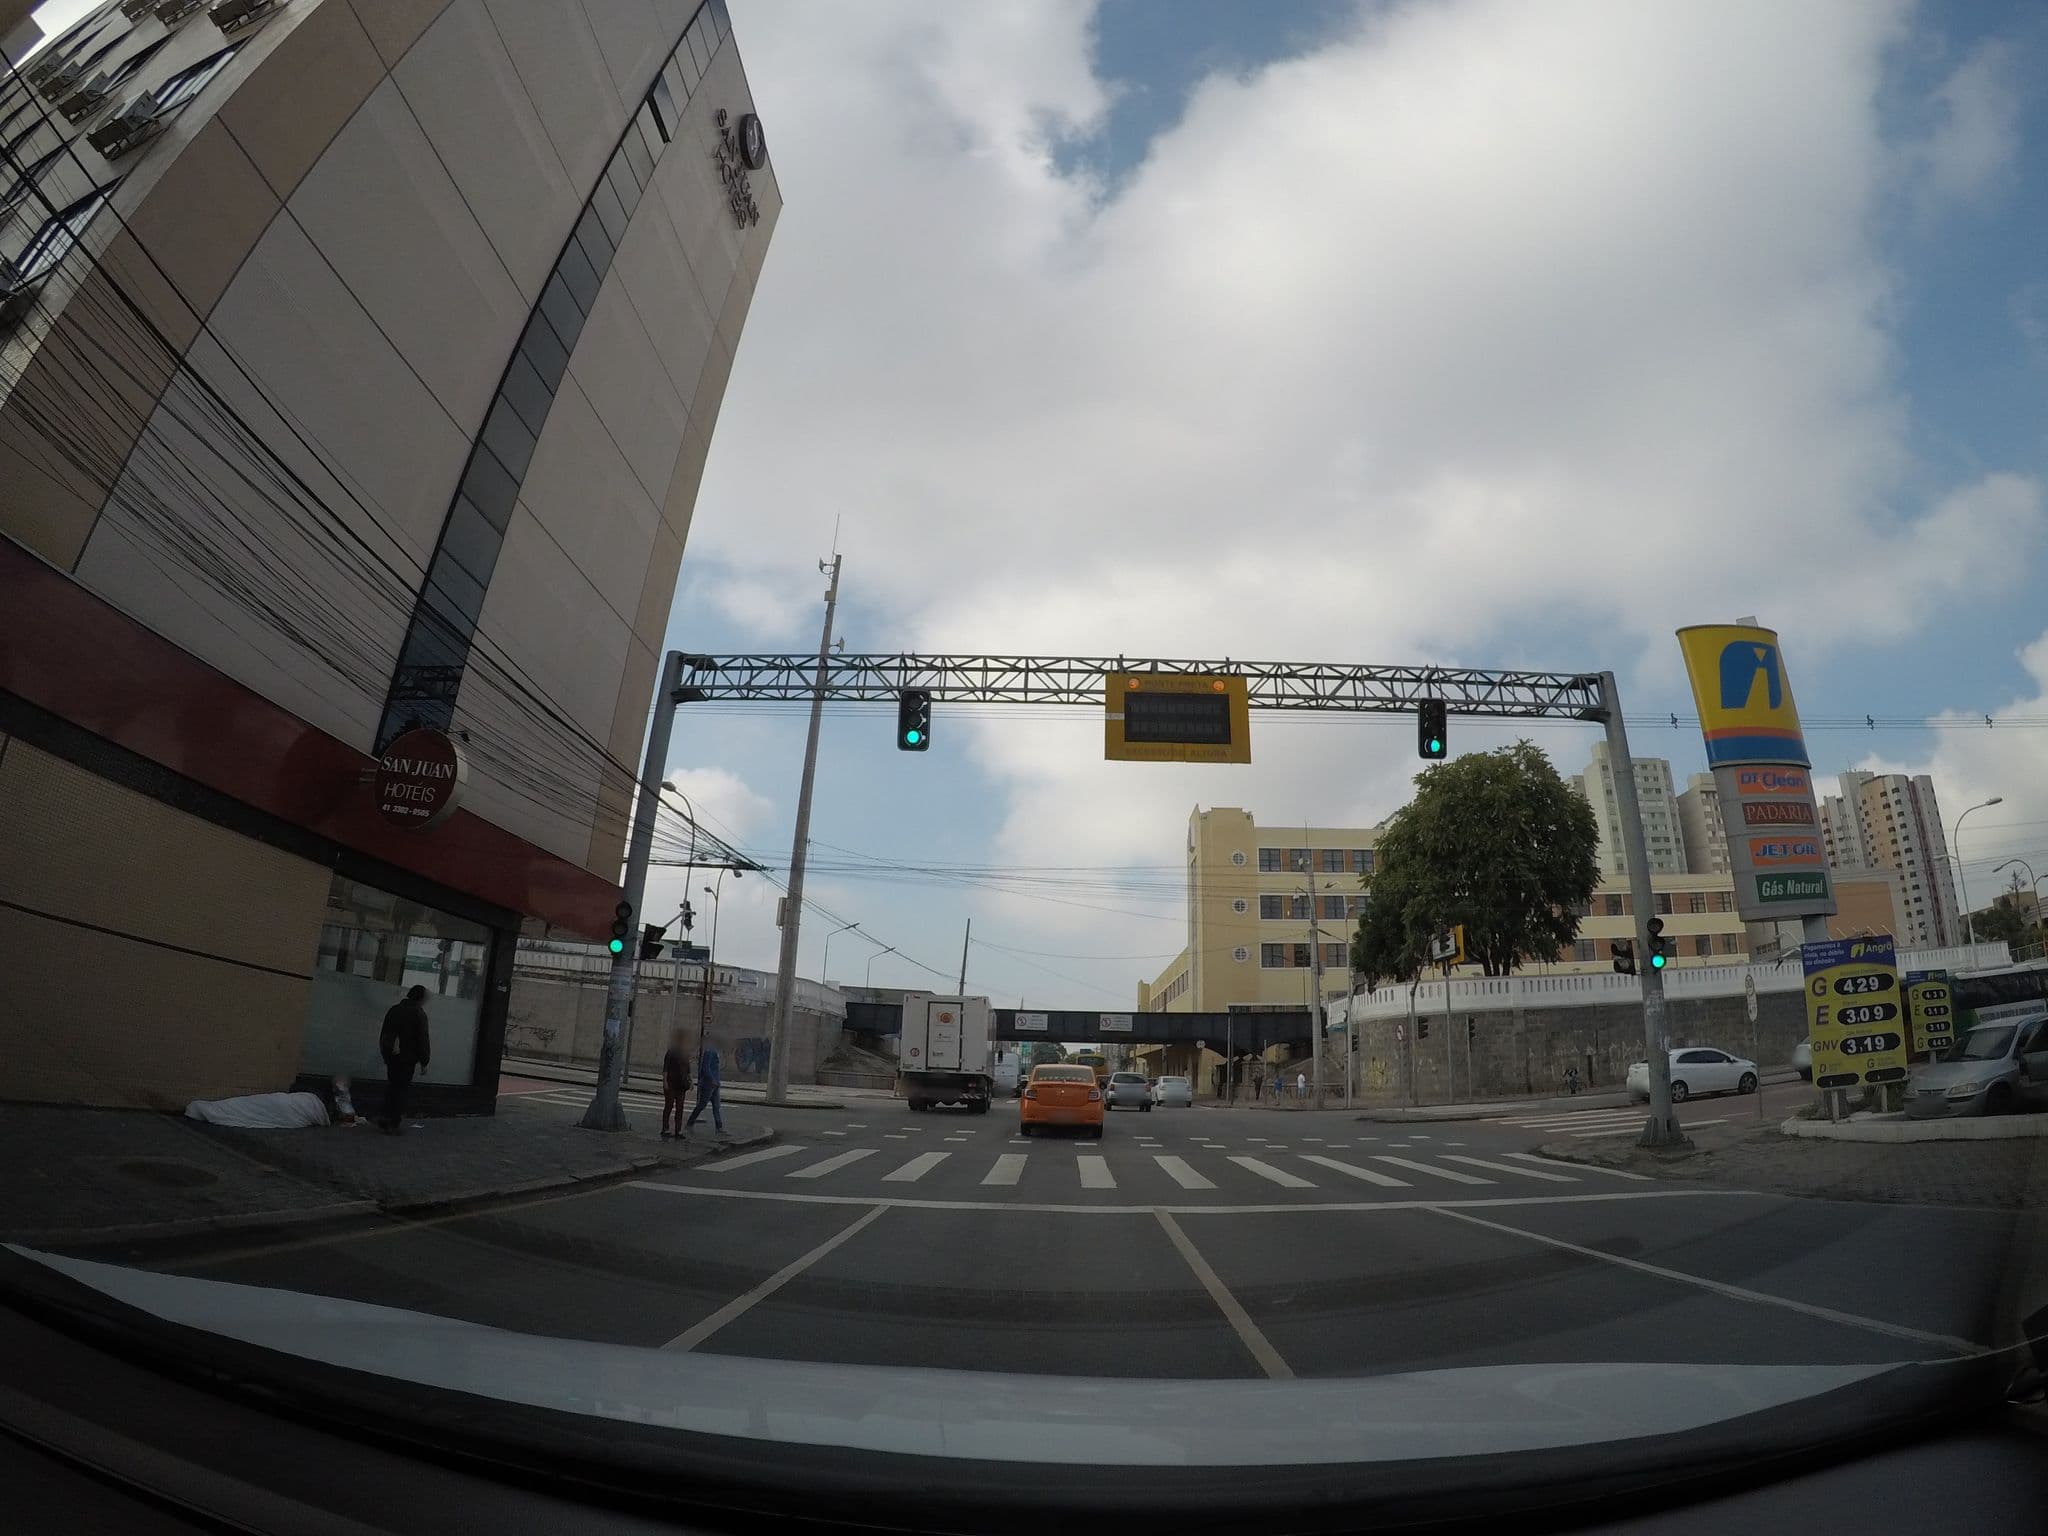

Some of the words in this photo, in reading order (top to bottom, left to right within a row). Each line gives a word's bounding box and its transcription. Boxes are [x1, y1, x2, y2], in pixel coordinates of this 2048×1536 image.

[381, 756, 412, 775] SAN
[411, 760, 455, 780] JUAN
[1746, 804, 1812, 821] PADARIA
[1762, 880, 1784, 897] Gás
[1787, 878, 1824, 896] Natural
[1812, 976, 1827, 997] G
[1816, 1005, 1830, 1025] E
[1814, 1040, 1839, 1053] GNV
